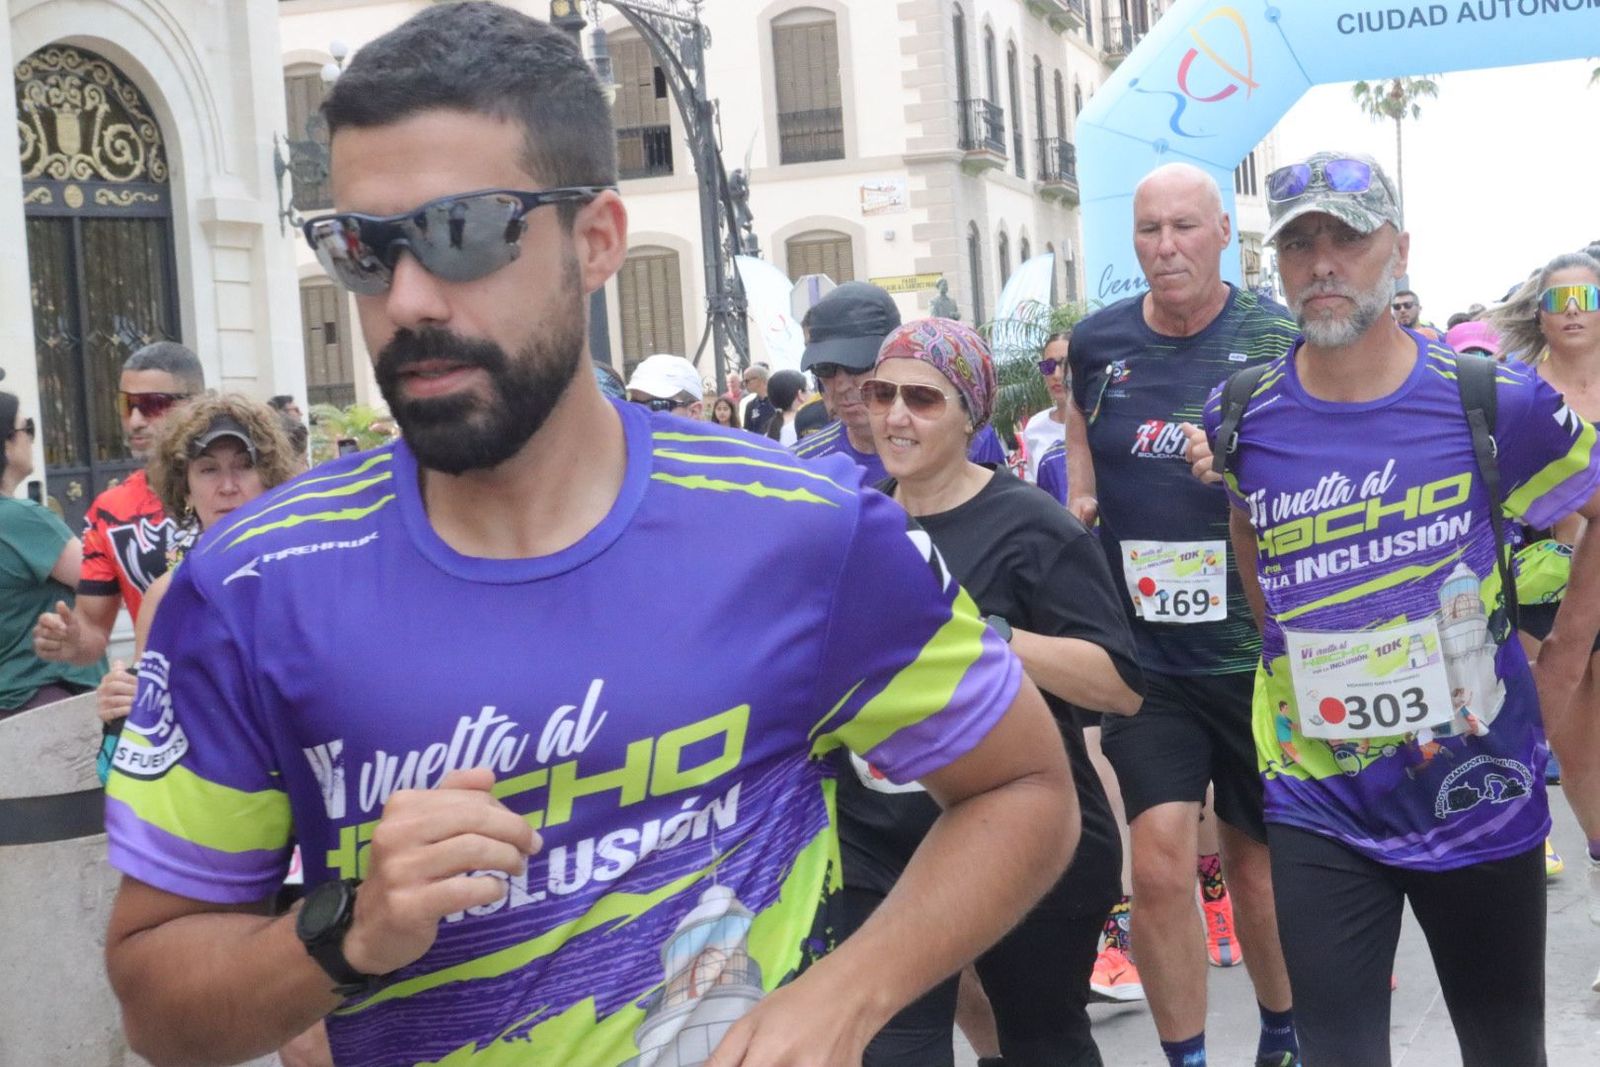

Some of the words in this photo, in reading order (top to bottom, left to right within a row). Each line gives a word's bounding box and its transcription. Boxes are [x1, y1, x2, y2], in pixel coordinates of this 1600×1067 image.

[1337, 4, 1448, 35] CIUDAD
[1273, 472, 1357, 522] vuelta
[1359, 459, 1397, 499] al
[1178, 550, 1199, 562] 10K
[1295, 510, 1473, 584] INCLUSIÓN
[1155, 589, 1210, 616] 169
[1374, 638, 1402, 658] 10K
[1344, 687, 1429, 730] 303
[359, 705, 530, 812] vuelta
[536, 678, 608, 763] al
